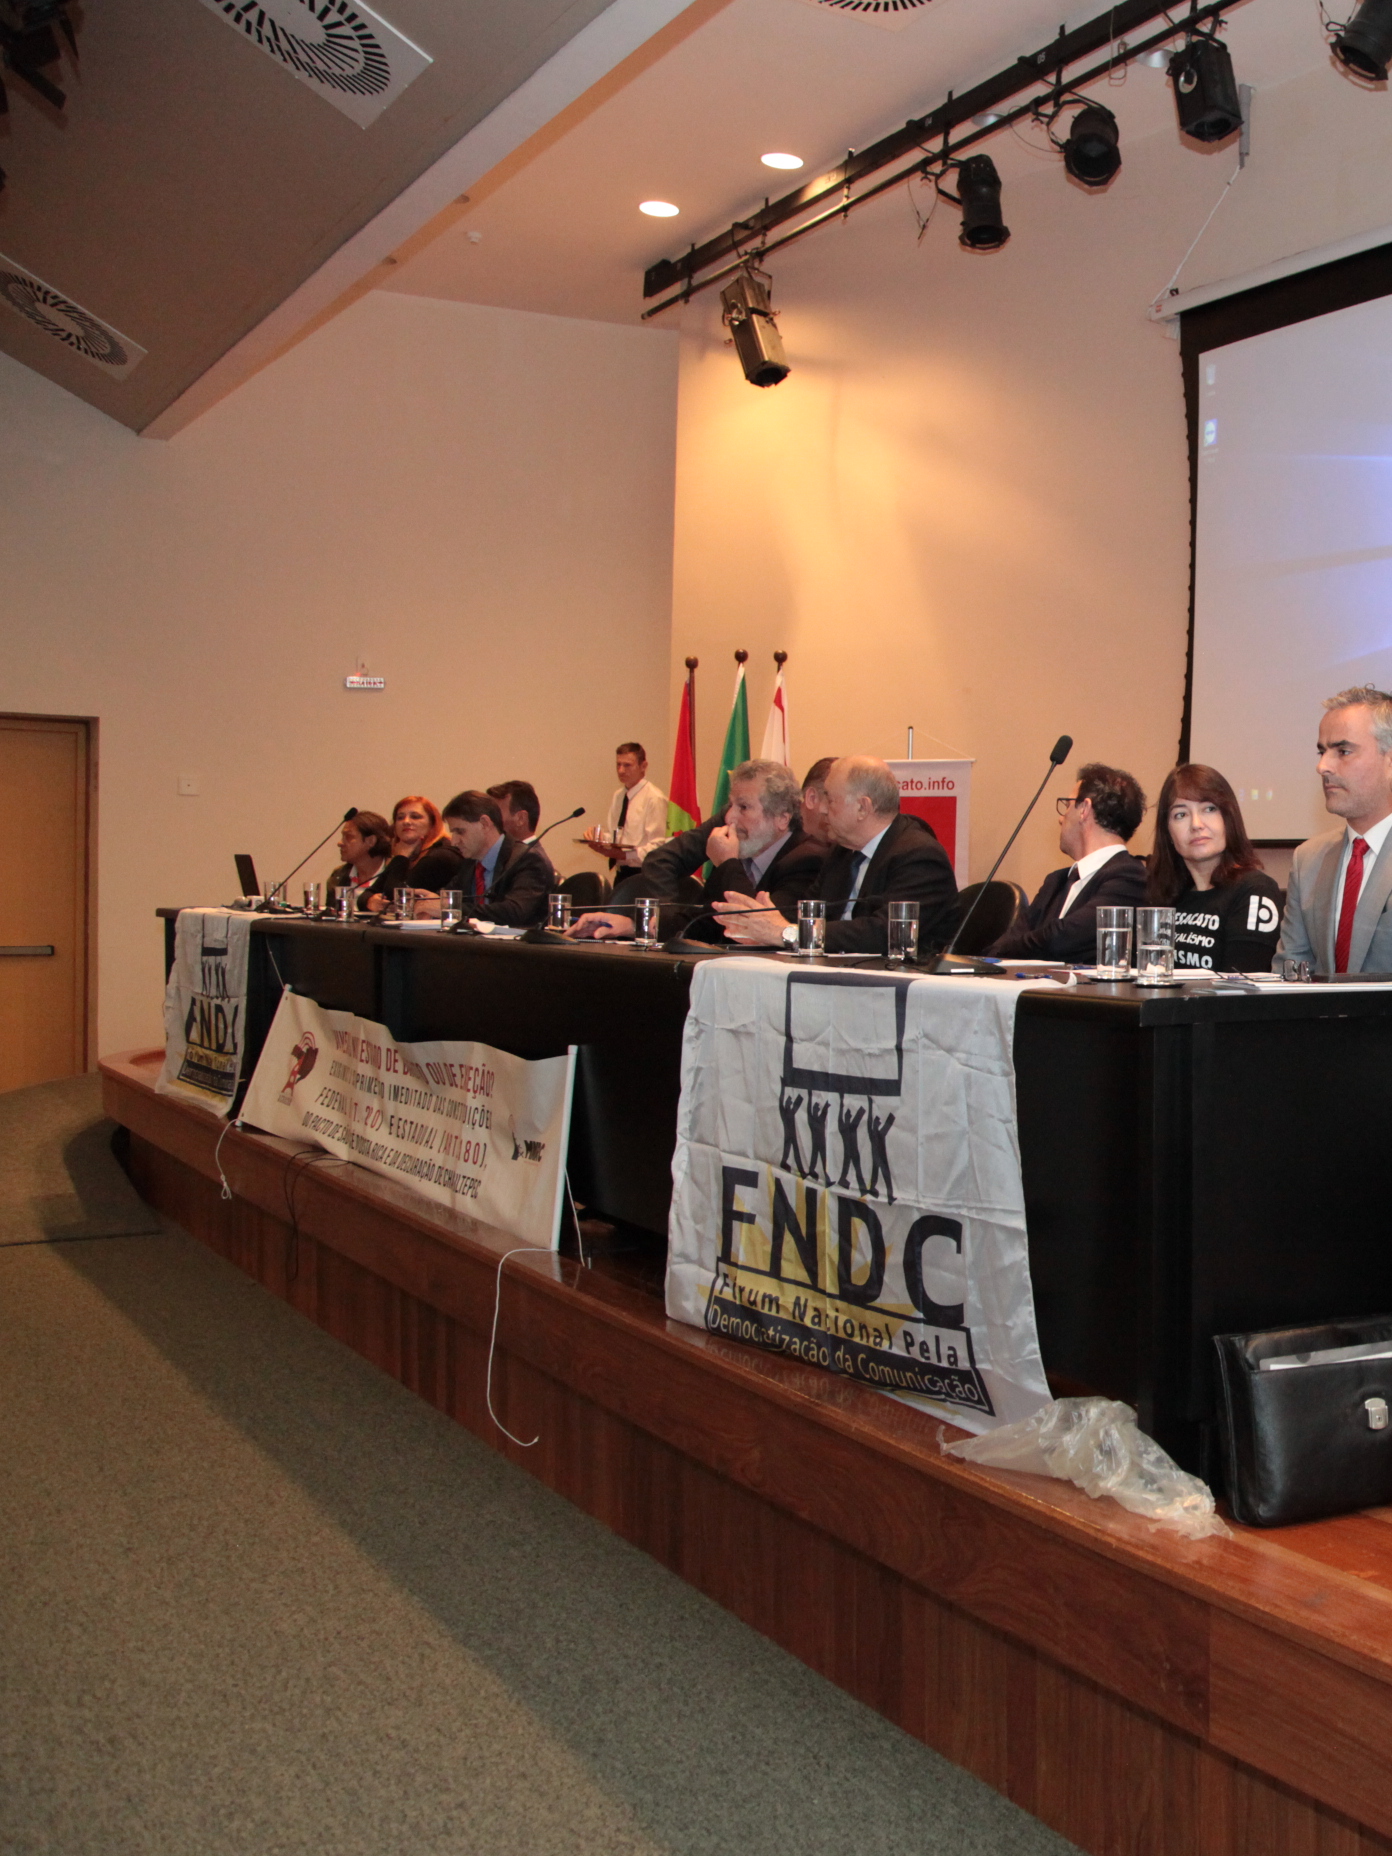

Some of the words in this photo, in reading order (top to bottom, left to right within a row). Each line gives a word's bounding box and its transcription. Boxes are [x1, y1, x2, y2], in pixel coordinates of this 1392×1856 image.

[1173, 912, 1220, 931] ESACATO
[1174, 949, 1213, 969] ISMO
[385, 1048, 399, 1074] DE
[425, 1062, 446, 1086] OU
[720, 1165, 965, 1326] FNDC
[902, 1329, 959, 1368] Pela
[834, 1344, 855, 1374] da
[857, 1353, 979, 1402] Comunicação
